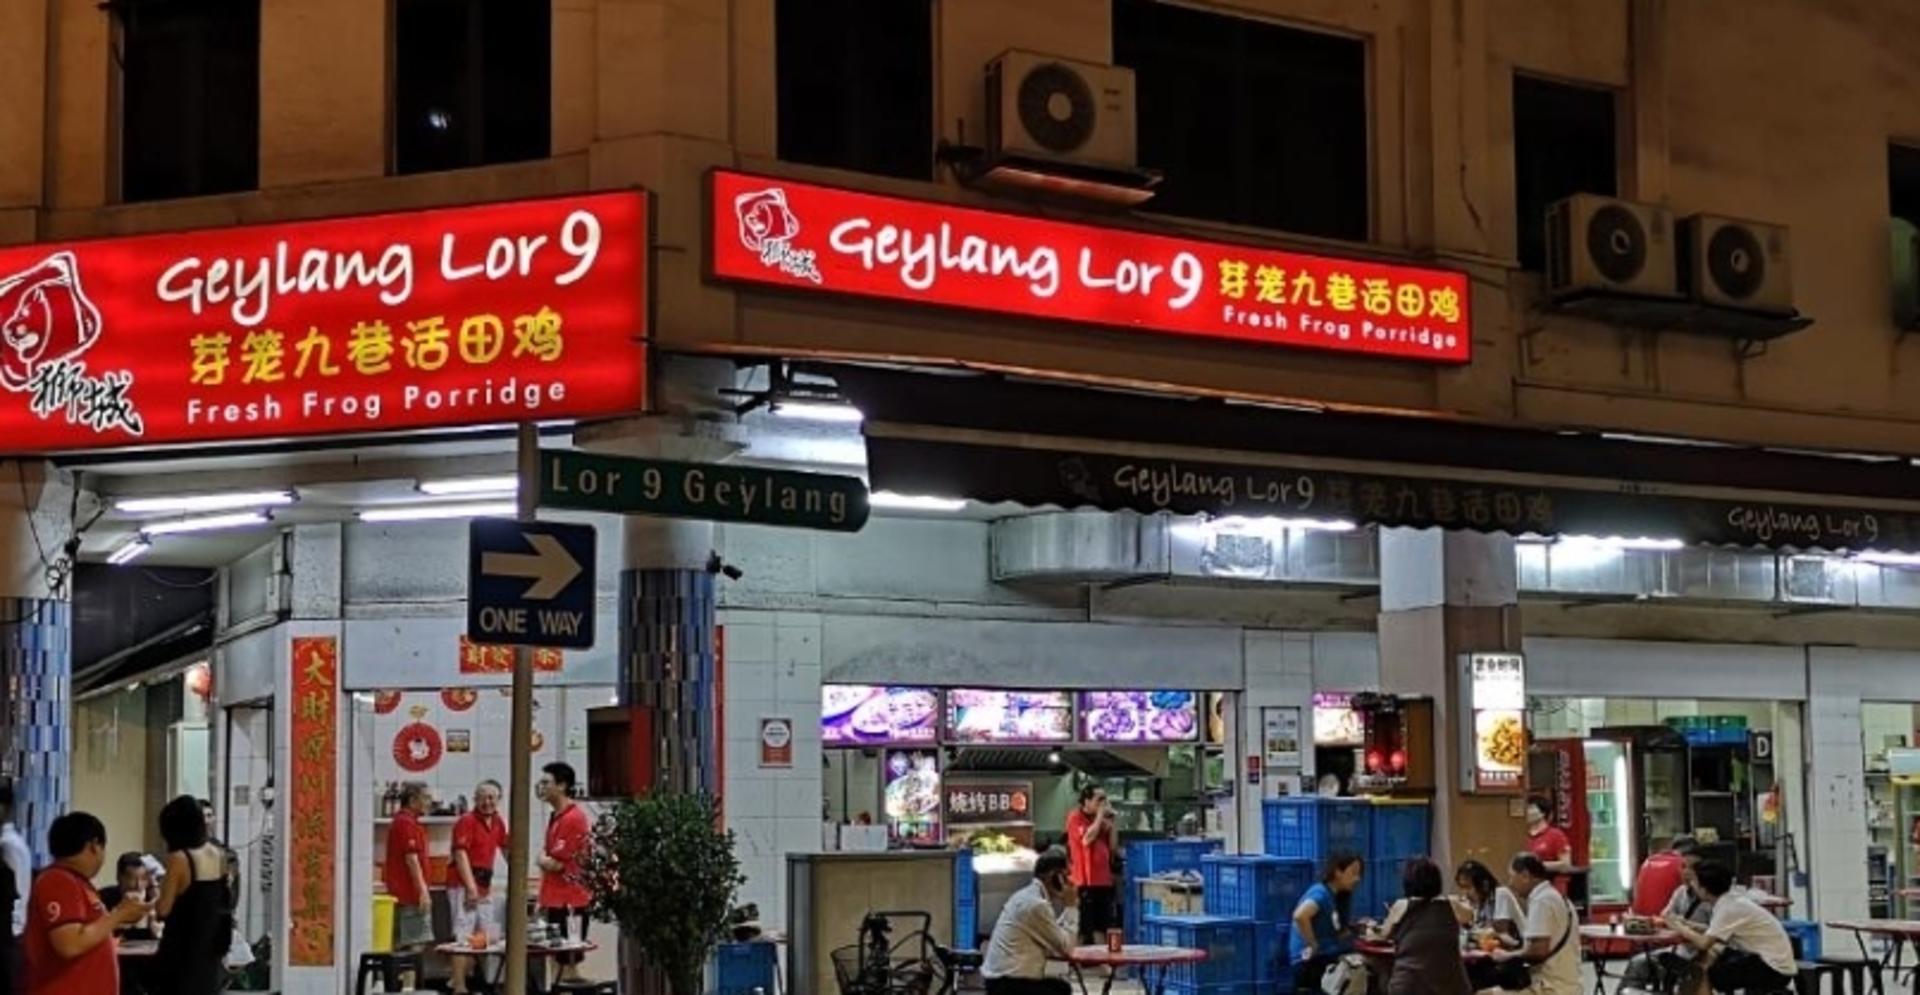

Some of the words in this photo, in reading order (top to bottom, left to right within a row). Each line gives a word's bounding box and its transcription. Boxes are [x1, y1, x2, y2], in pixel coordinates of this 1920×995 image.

[157, 241, 413, 326] Geylang
[440, 233, 547, 279] Lor
[555, 210, 601, 285] 9
[829, 217, 1060, 298] Geylang
[1078, 247, 1164, 295] Lor
[1168, 252, 1204, 309] 9
[1223, 305, 1288, 330] Fresh
[1300, 314, 1350, 340] Frog
[1362, 321, 1457, 350] Porridge
[187, 394, 282, 424] Fresh
[303, 391, 380, 419] Frog
[404, 377, 565, 410] Porridge
[552, 458, 621, 497] Lor
[643, 466, 662, 499] 9
[684, 469, 847, 523] Geylang
[1113, 463, 1236, 503] Geylang
[1246, 474, 1292, 503] Lor
[1297, 476, 1316, 511] 9
[1728, 506, 1820, 540] Geylang
[1826, 512, 1861, 538] Lor
[1864, 512, 1878, 543] 9
[478, 606, 527, 635] ONE
[538, 610, 585, 637] WAY
[1756, 736, 1770, 758] D
[47, 901, 61, 922] 9
